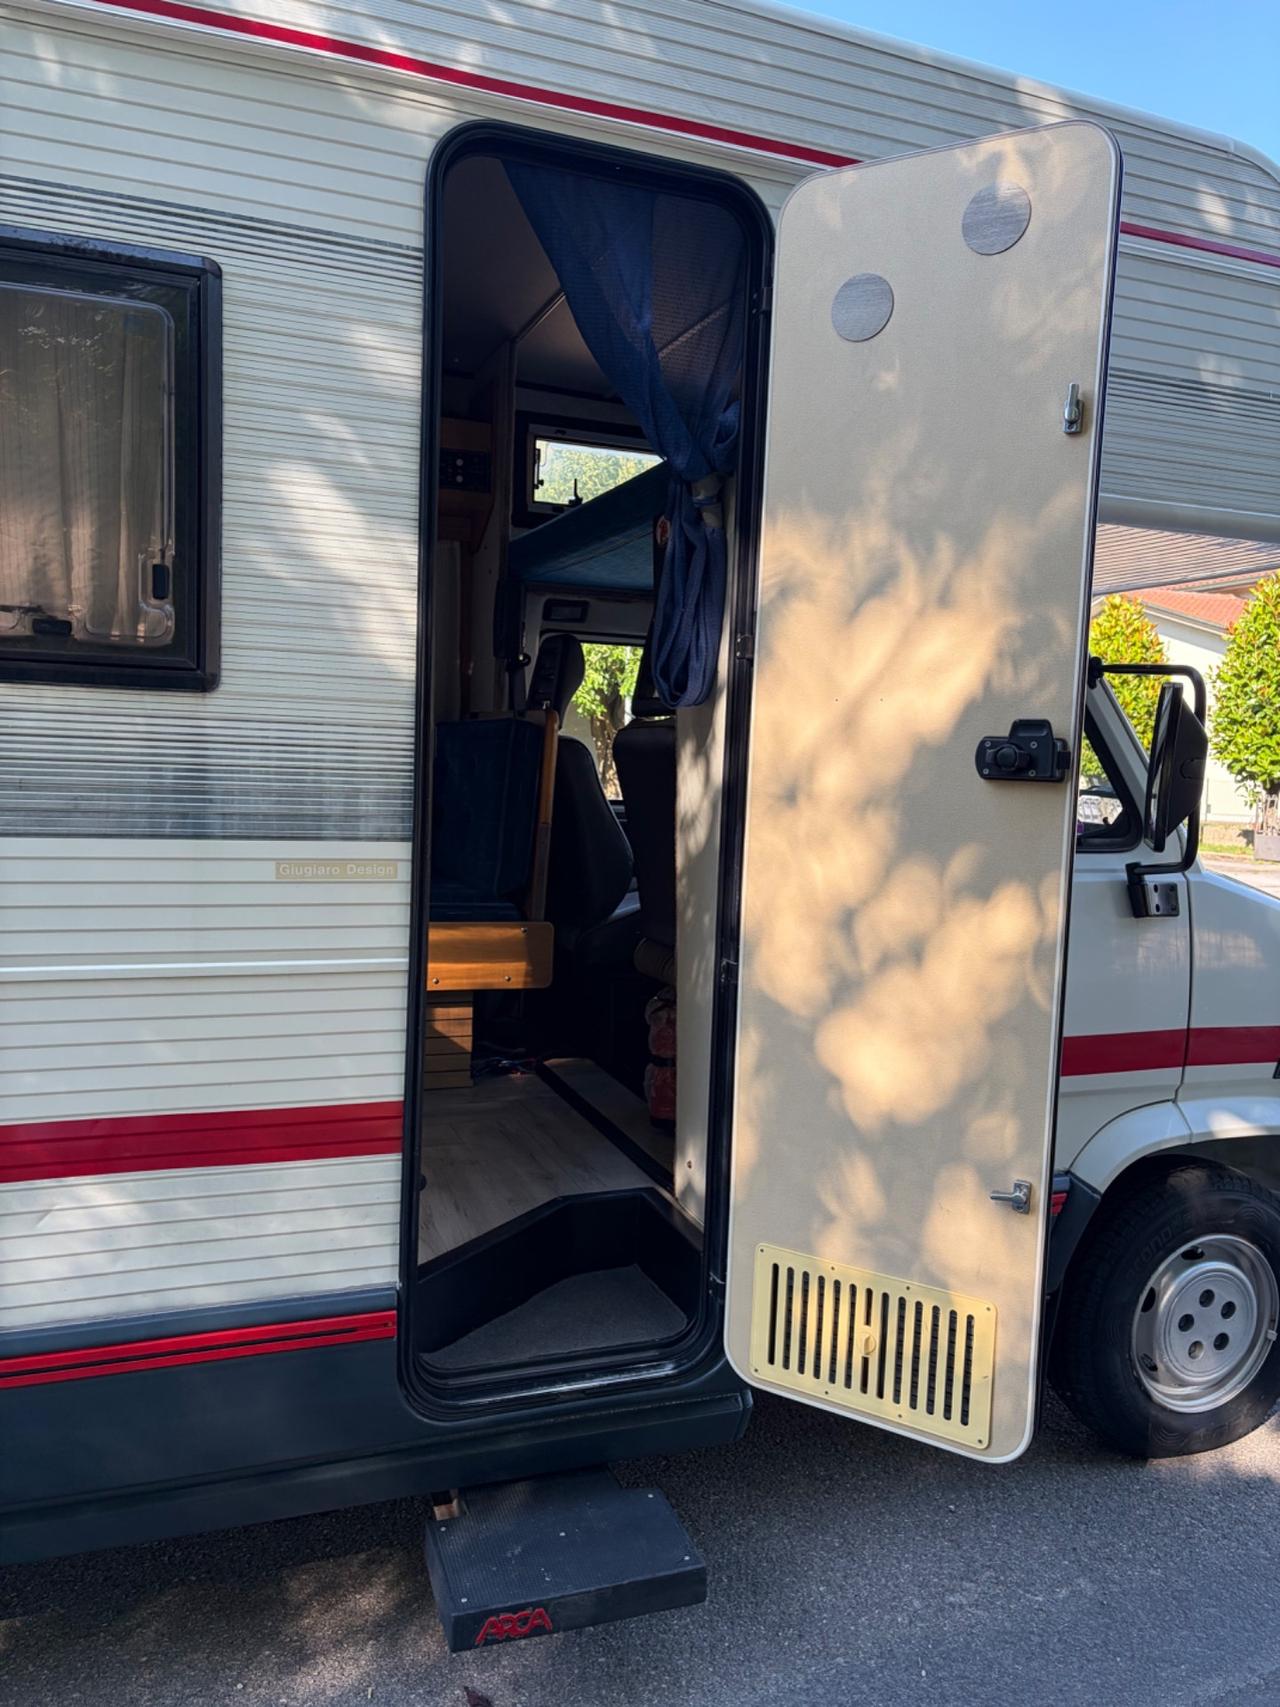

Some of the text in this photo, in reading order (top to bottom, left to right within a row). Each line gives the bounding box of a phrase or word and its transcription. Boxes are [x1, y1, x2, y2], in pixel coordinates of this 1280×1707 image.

[280, 864, 393, 876] Giugiaro Design
[475, 1608, 553, 1645] ARCA
